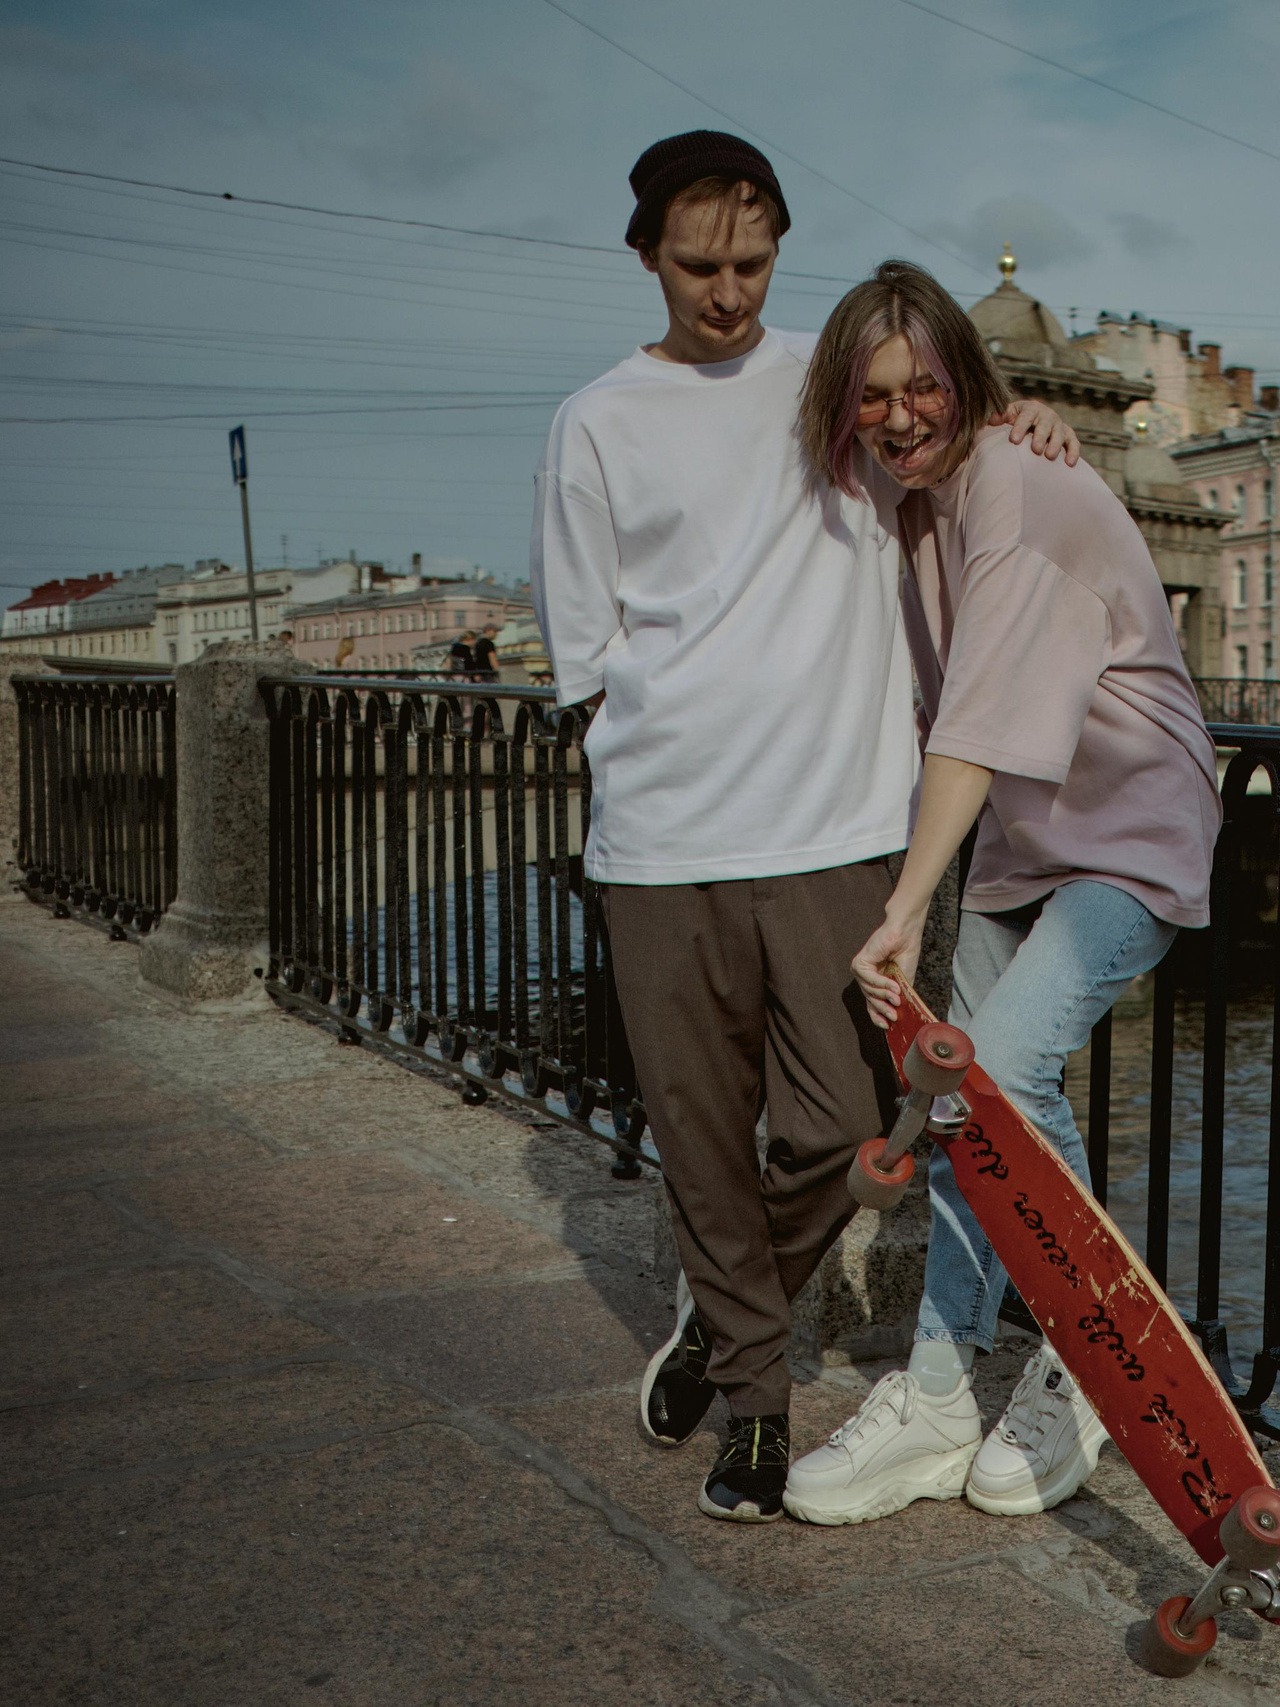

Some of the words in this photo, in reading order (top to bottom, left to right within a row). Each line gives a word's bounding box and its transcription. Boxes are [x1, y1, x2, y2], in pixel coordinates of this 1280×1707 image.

[965, 1123, 1008, 1180] die
[1014, 1192, 1082, 1288] never
[1078, 1304, 1144, 1381] will
